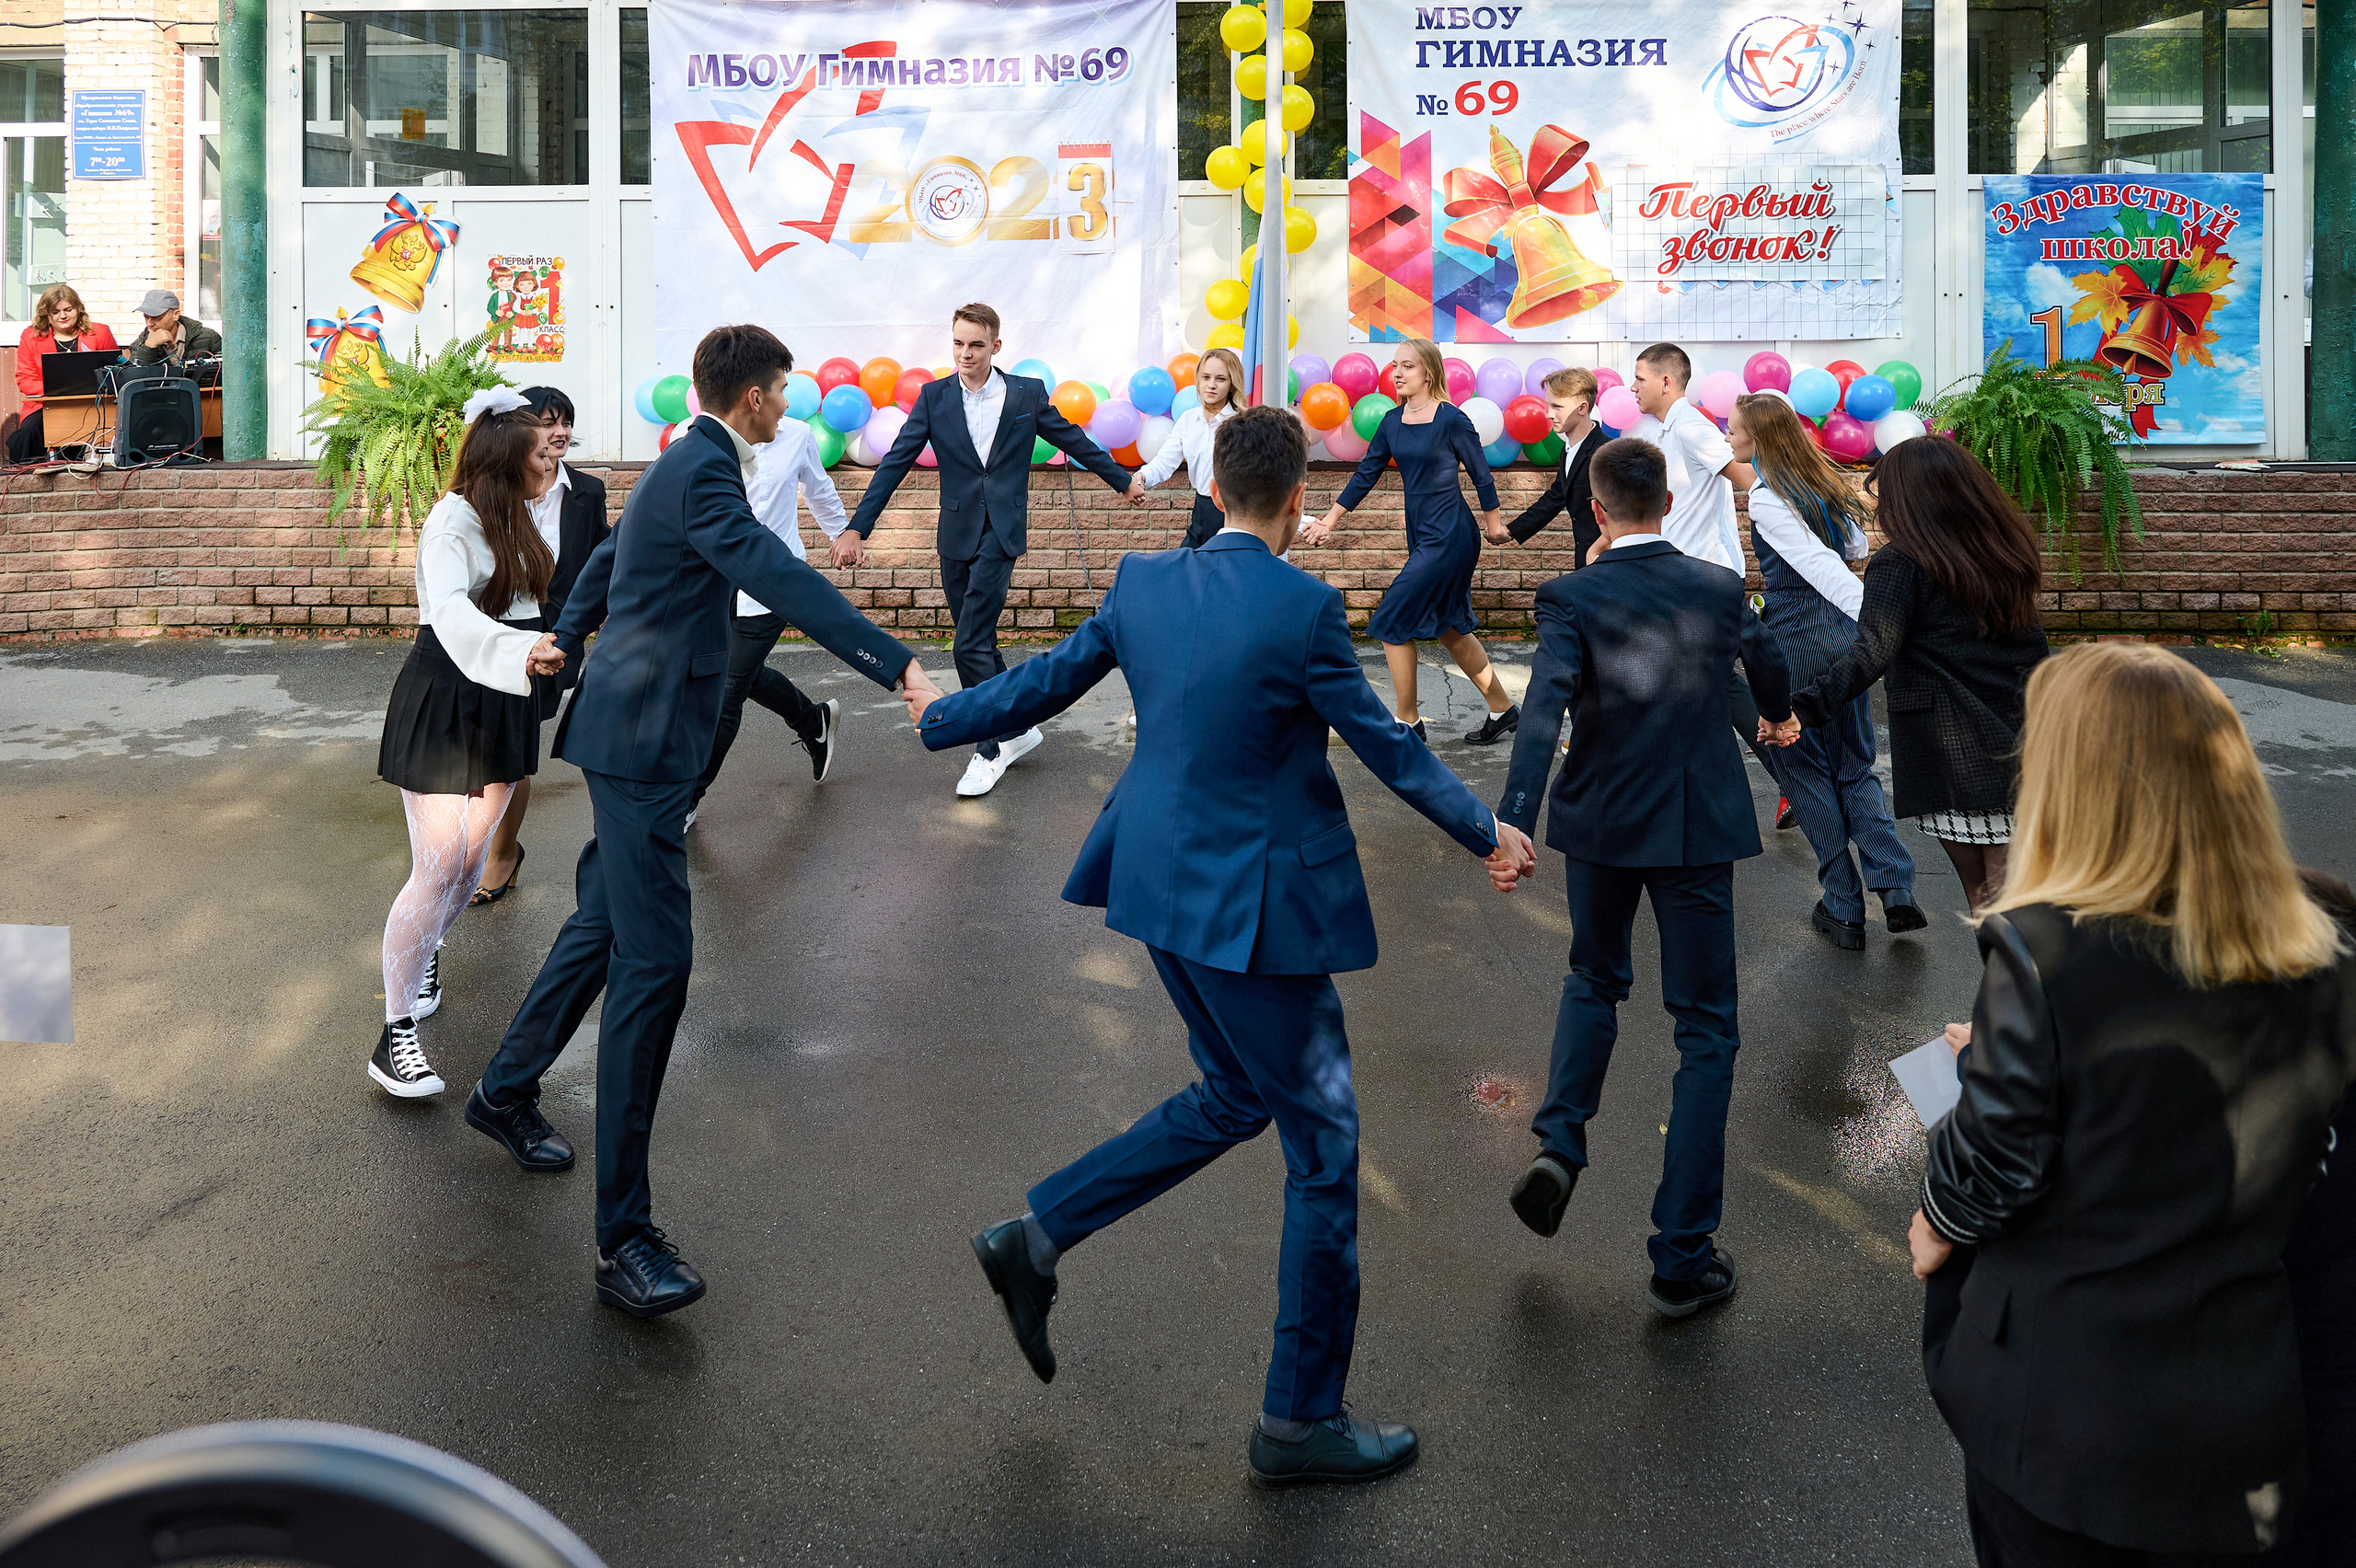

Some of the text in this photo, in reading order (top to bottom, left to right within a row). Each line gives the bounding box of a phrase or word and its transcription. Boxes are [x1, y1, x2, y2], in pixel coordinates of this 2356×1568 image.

[1415, 6, 1523, 29] МБОУ
[687, 53, 806, 87] МБОУ
[817, 53, 1021, 86] Гимназия
[1415, 39, 1668, 67] ГИМНАЗИЯ
[1454, 80, 1519, 116] 69
[1769, 60, 1867, 138] The place where Stars are Born
[1638, 179, 1835, 232] Первый
[1990, 183, 2241, 242] Здравствуй
[502, 255, 534, 265] ПЕРВЫЙ
[1656, 225, 1839, 275] звонок!
[2040, 228, 2193, 261] школа!
[2030, 306, 2071, 380] 1
